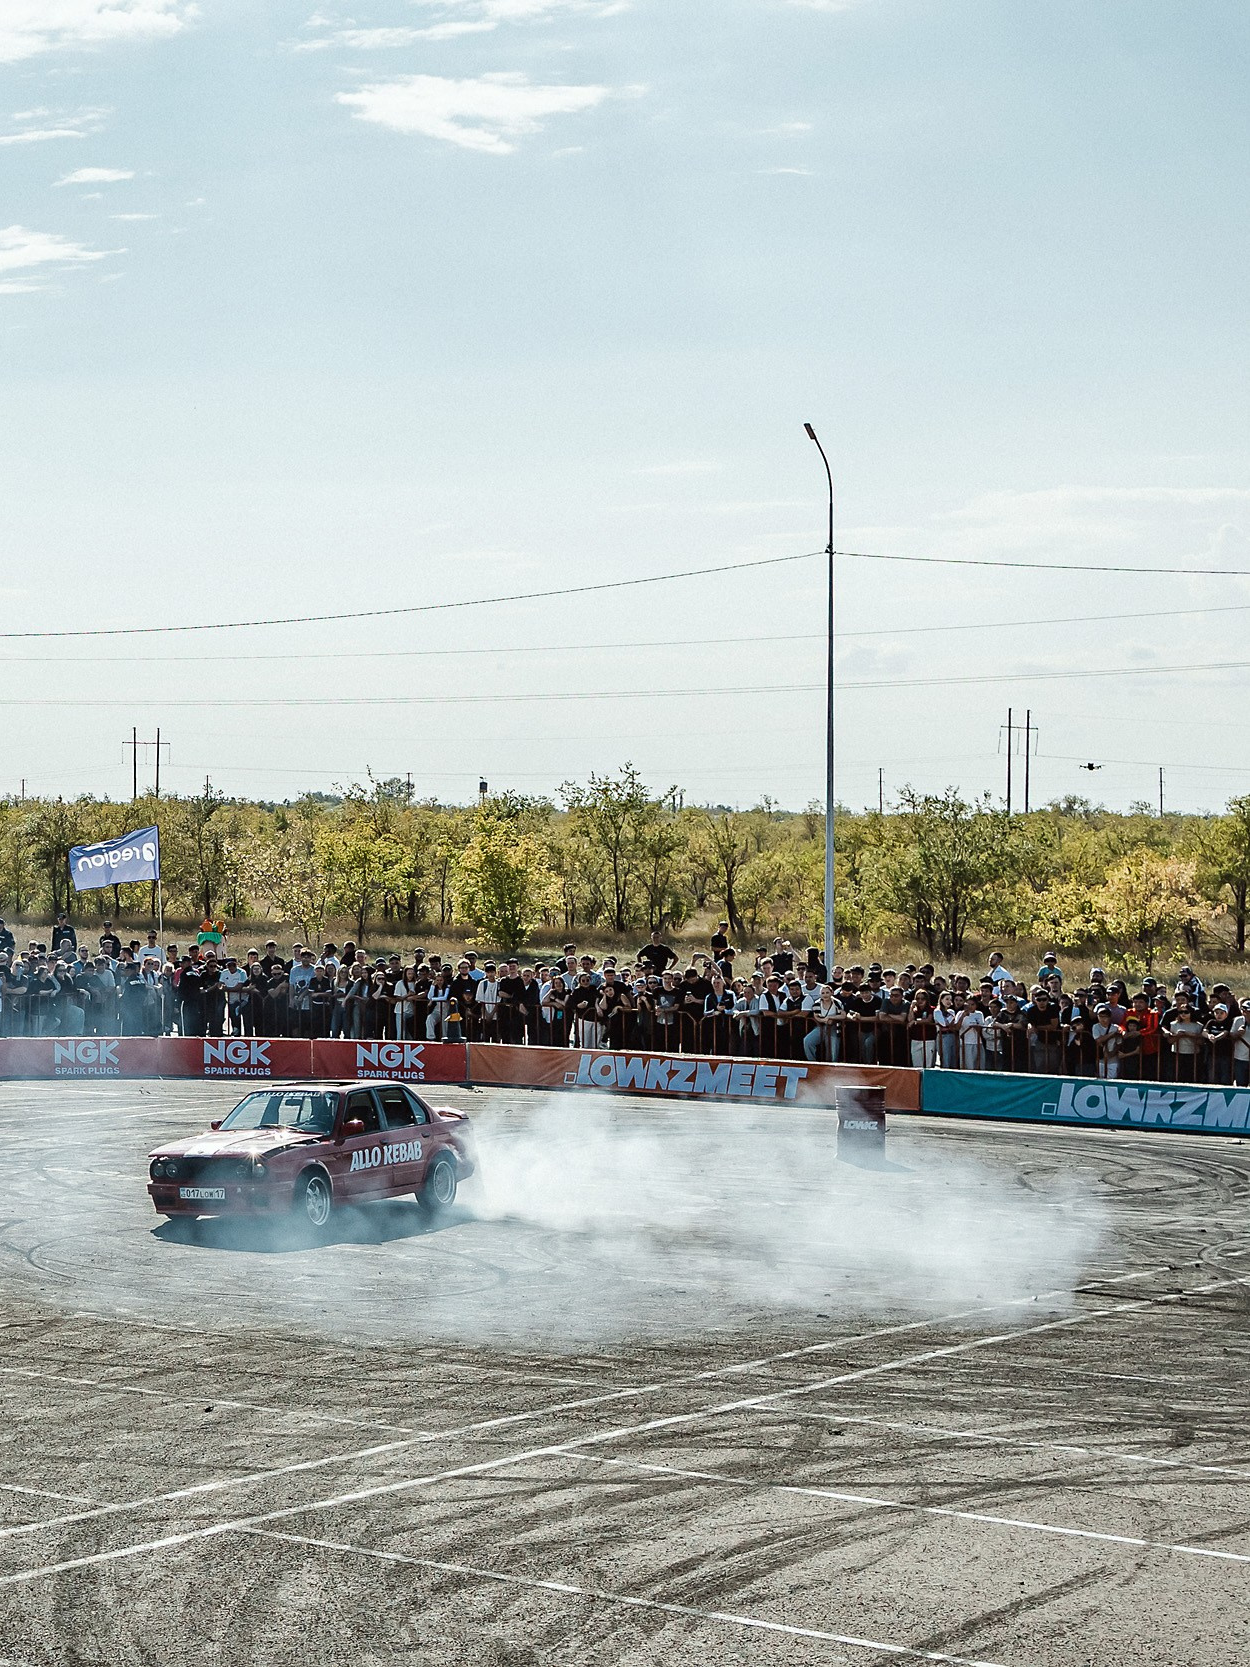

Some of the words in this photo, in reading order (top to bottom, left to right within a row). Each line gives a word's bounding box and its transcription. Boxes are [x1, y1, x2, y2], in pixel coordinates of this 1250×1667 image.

[54, 1040, 120, 1065] NGK
[203, 1040, 272, 1066] NGK
[356, 1043, 425, 1069] NGK
[55, 1066, 86, 1075] SPARK
[88, 1066, 120, 1075] PLUGS
[204, 1066, 236, 1075] SPARK
[238, 1067, 271, 1076] PLUGS
[357, 1069, 390, 1079] SPARK
[391, 1070, 425, 1080] PLUGS
[576, 1054, 808, 1099] LOWKZMEET
[1057, 1083, 1250, 1128] LOWKZM
[350, 1147, 382, 1172] ALLO
[383, 1141, 423, 1165] KEBAB
